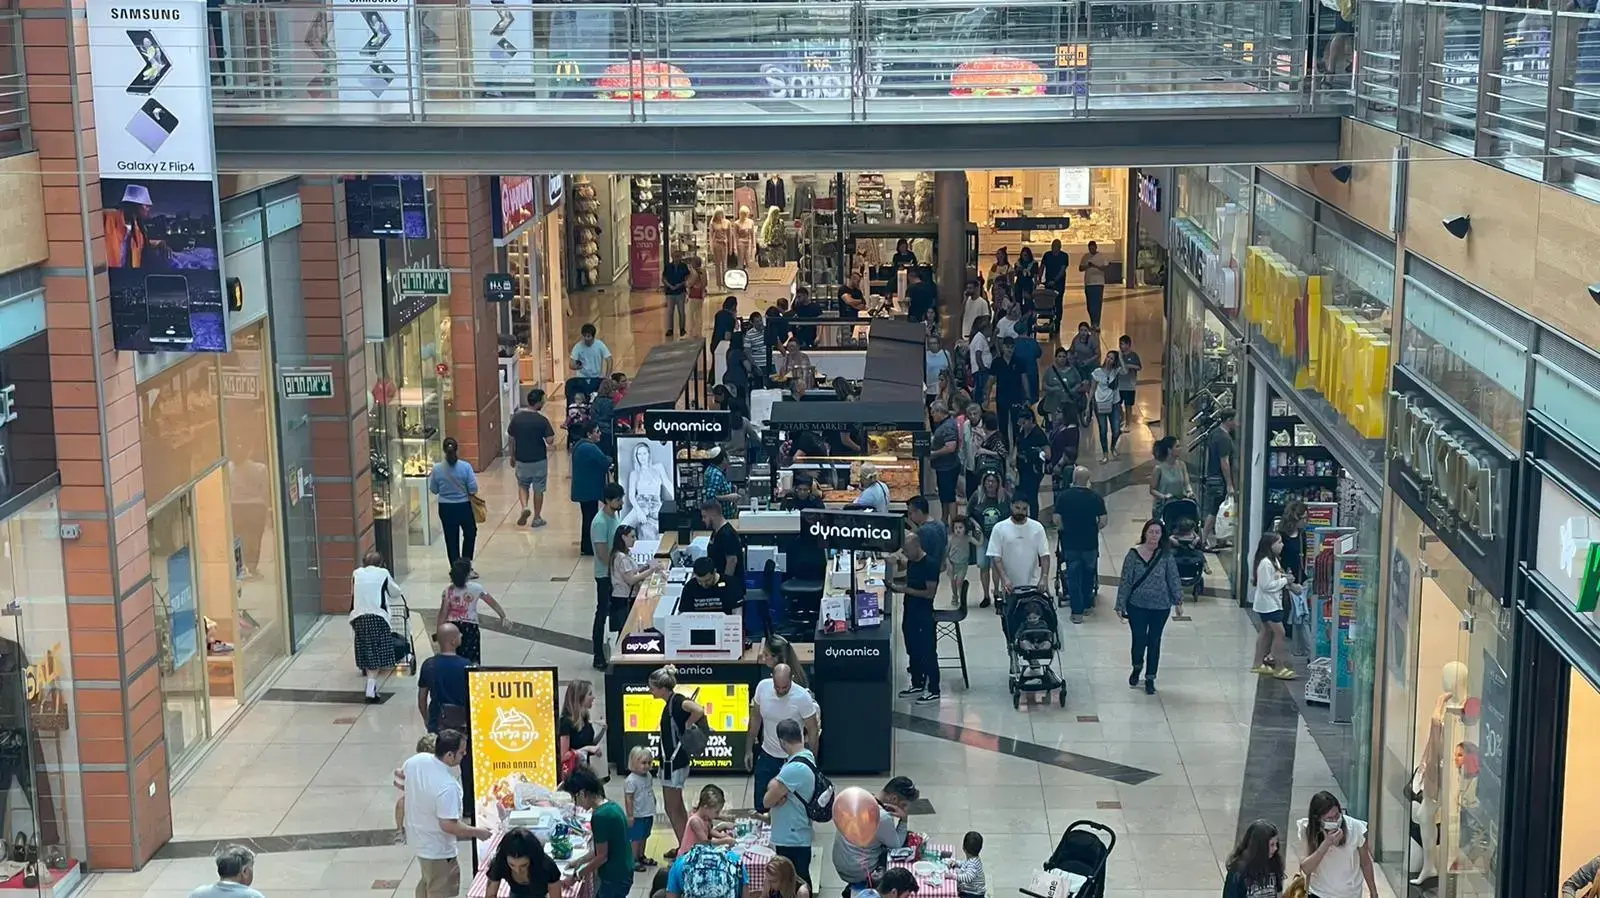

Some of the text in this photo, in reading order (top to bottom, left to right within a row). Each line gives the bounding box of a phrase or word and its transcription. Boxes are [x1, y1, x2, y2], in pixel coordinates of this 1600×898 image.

[110, 7, 180, 21] SAMSUNG
[117, 160, 195, 173] Galaxy Z Flip4
[633, 225, 657, 241] 50
[401, 272, 447, 290] יציאת חרום
[285, 375, 329, 393] יציאת חרום
[653, 419, 722, 434] dynamica
[809, 521, 892, 540] dynamica
[626, 642, 649, 651] סלקום
[825, 646, 880, 658] dynamica
[490, 681, 533, 699] חדש!
[493, 760, 537, 771] במתחם המזון
